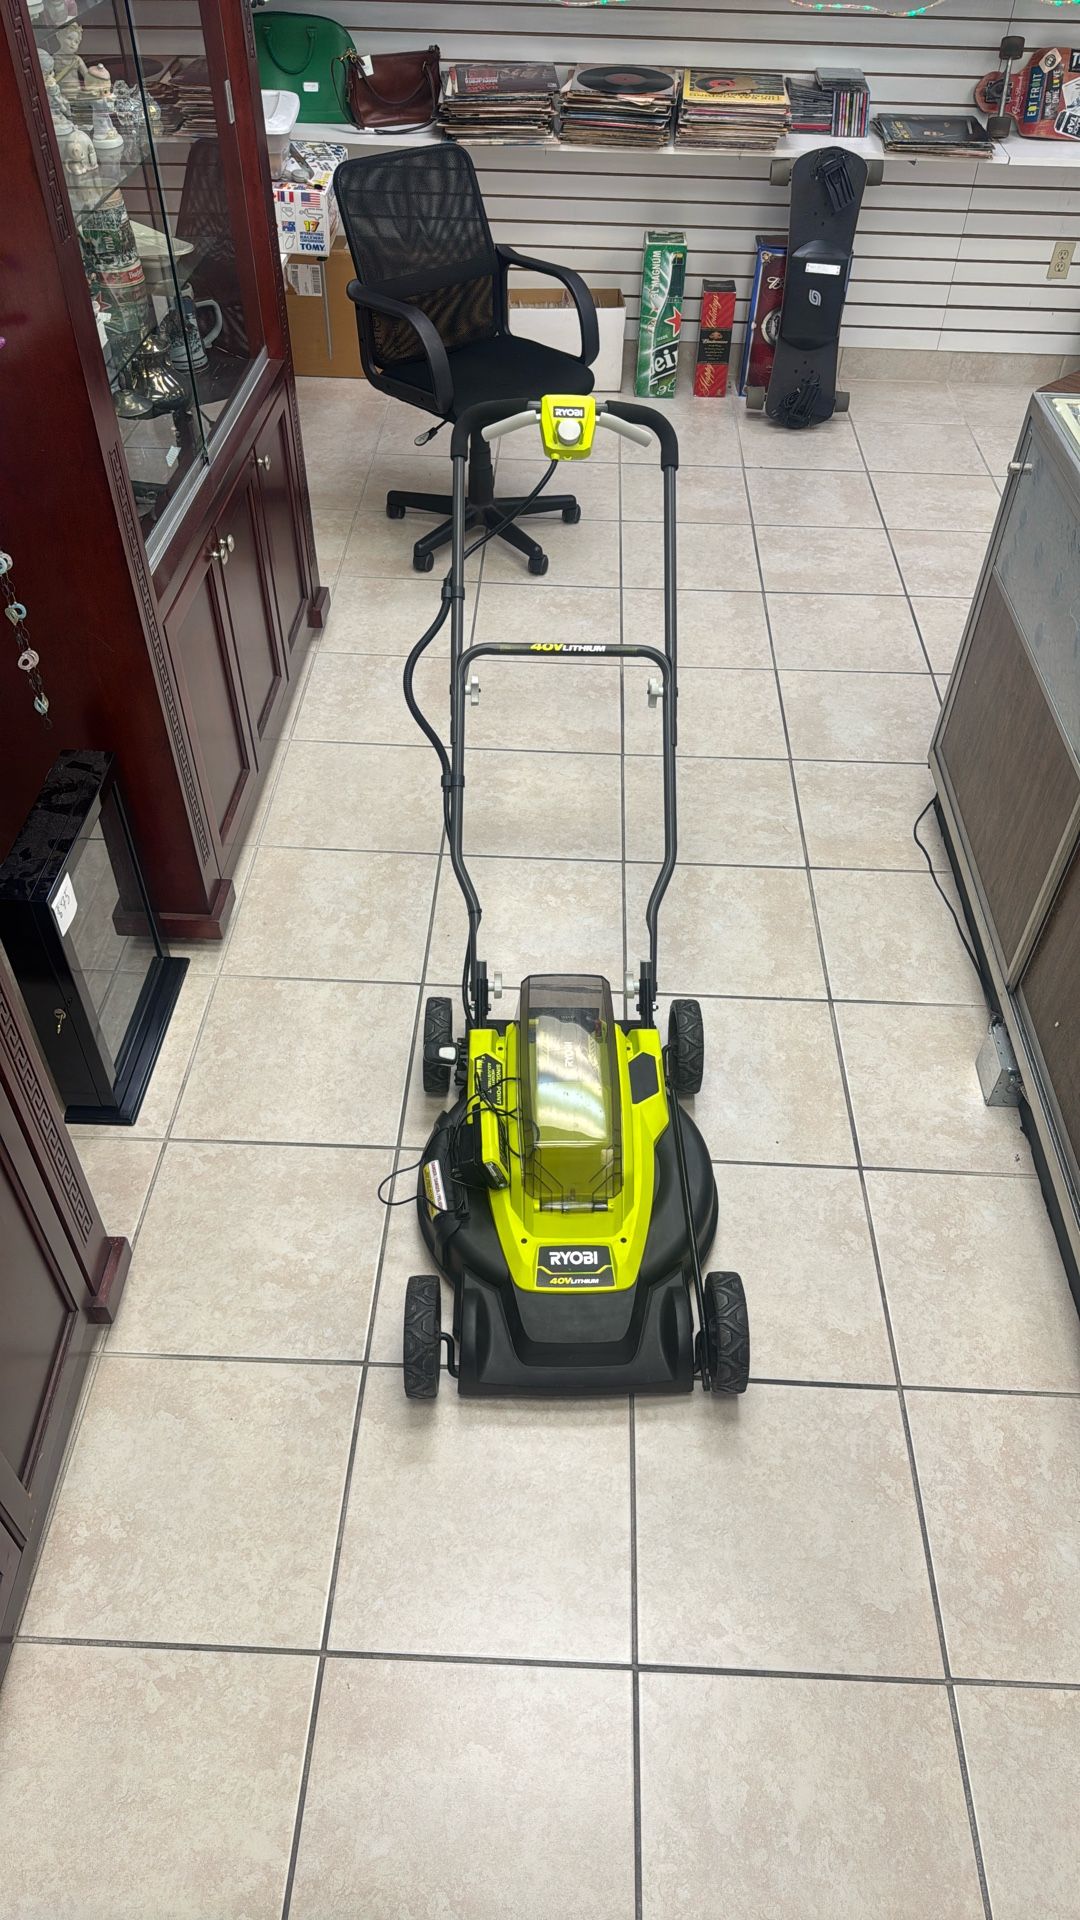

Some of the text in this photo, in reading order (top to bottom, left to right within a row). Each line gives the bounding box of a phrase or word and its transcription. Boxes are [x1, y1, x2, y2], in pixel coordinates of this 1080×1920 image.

[303, 220, 320, 232] 17
[651, 250, 662, 289] MAGNUM
[554, 408, 583, 417] RYOBI
[549, 1250, 599, 1265] RYOBI
